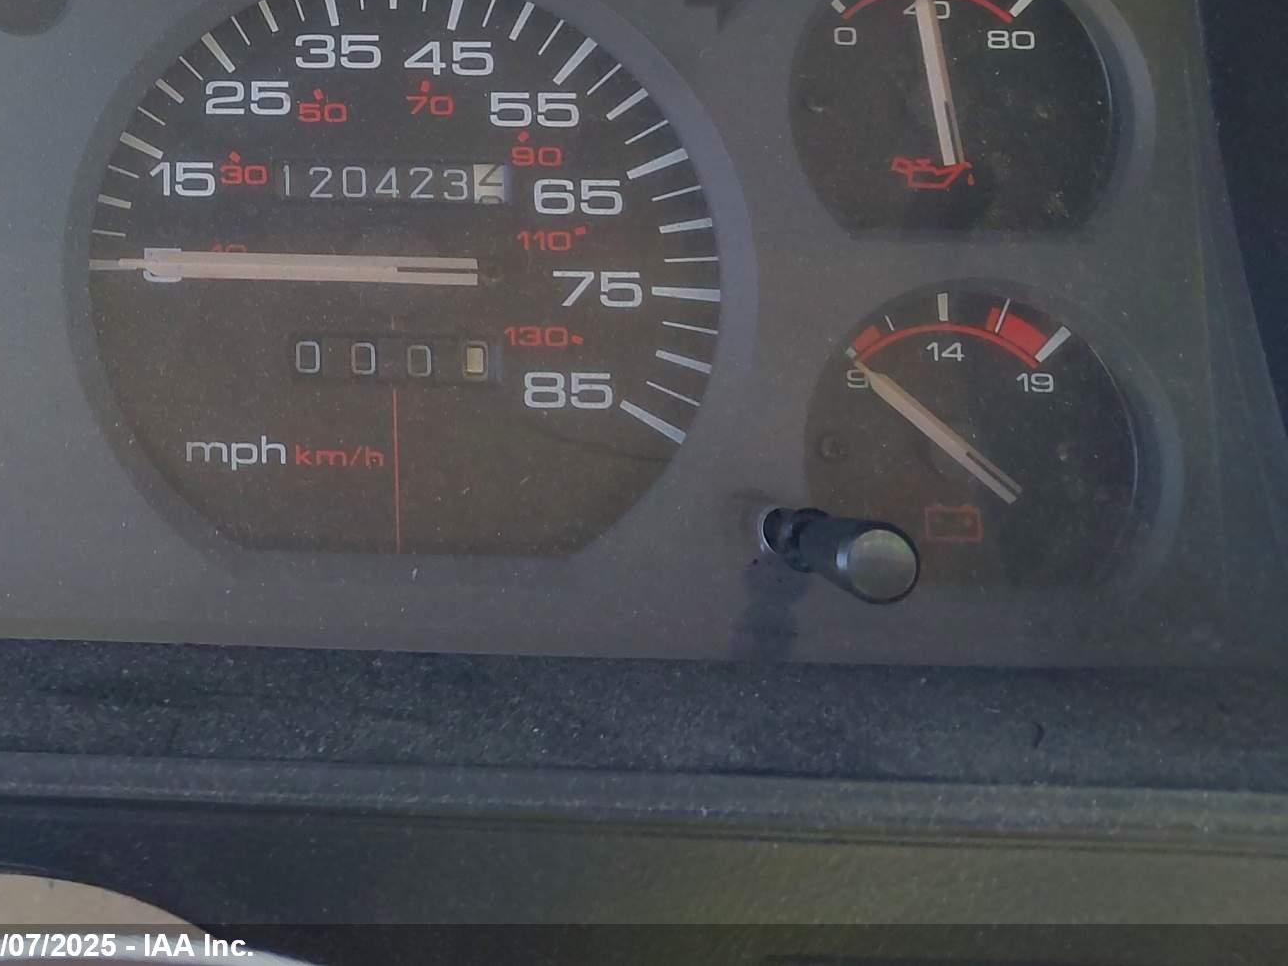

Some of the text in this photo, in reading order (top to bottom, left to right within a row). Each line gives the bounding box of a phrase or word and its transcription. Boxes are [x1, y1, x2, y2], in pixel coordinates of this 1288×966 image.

[833, 26, 857, 46] 0
[987, 30, 1035, 50] 80
[295, 34, 381, 69] 35
[403, 41, 494, 76] 45
[204, 80, 291, 116] 25
[407, 94, 454, 117] 70
[298, 102, 347, 124] 50
[489, 92, 579, 128] 55
[511, 144, 562, 167] 90
[150, 161, 215, 197] 15
[220, 164, 268, 186] 30
[532, 179, 623, 217] 65
[517, 230, 571, 251] 110
[552, 271, 642, 308] 75
[504, 326, 568, 347] 130
[926, 342, 965, 362] 14
[523, 372, 612, 409] 85
[1016, 373, 1054, 393] 19
[186, 435, 385, 471] mph km/h
